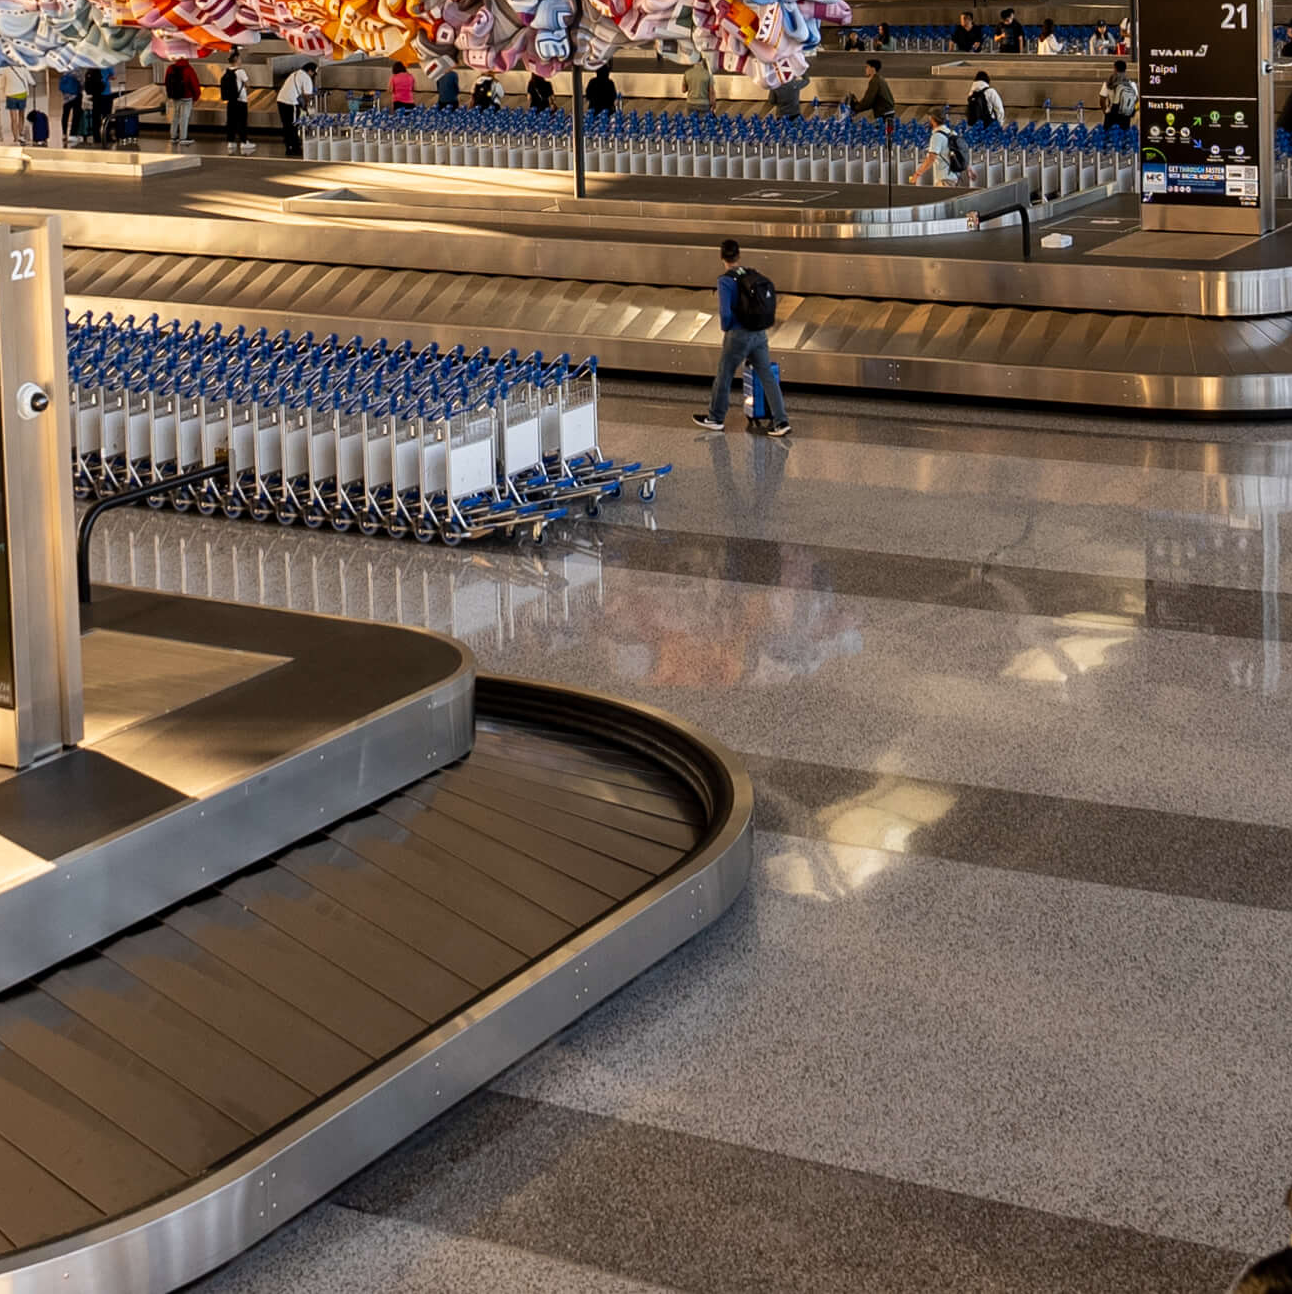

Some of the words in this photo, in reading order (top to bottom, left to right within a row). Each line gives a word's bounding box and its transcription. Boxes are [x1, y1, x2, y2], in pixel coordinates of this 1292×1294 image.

[1220, 3, 1248, 29] 21
[1149, 64, 1177, 75] Taipei
[1149, 75, 1161, 85] 26
[1148, 101, 1164, 110] Next
[1164, 101, 1185, 111] Steps
[10, 247, 37, 281] 22
